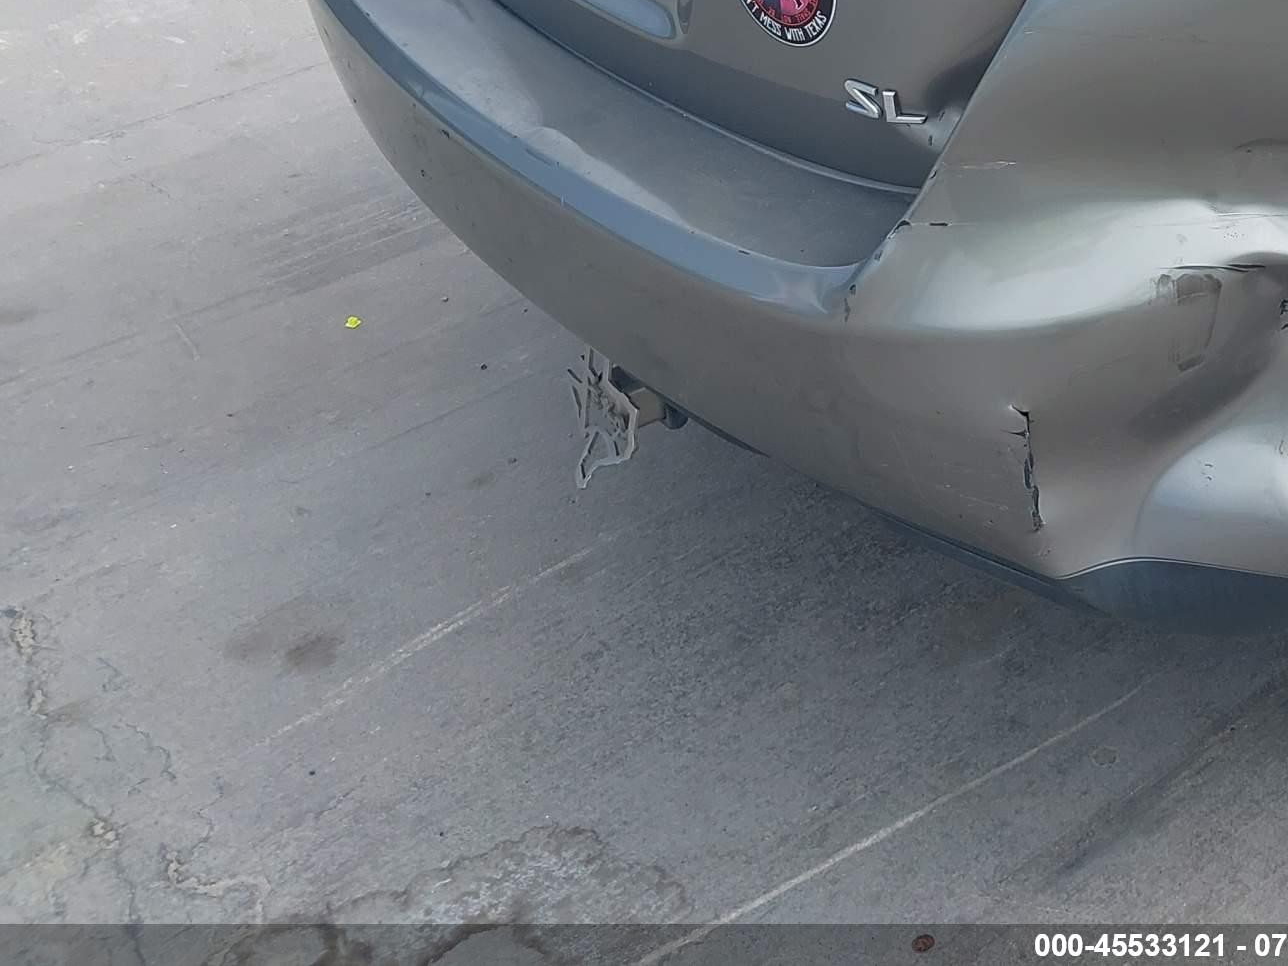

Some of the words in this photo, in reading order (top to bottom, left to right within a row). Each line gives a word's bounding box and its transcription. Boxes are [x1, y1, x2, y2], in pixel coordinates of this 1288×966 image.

[759, 11, 782, 37] MESS
[785, 26, 806, 42] WITH
[805, 10, 828, 40] TEXAS
[844, 78, 927, 124] SL
